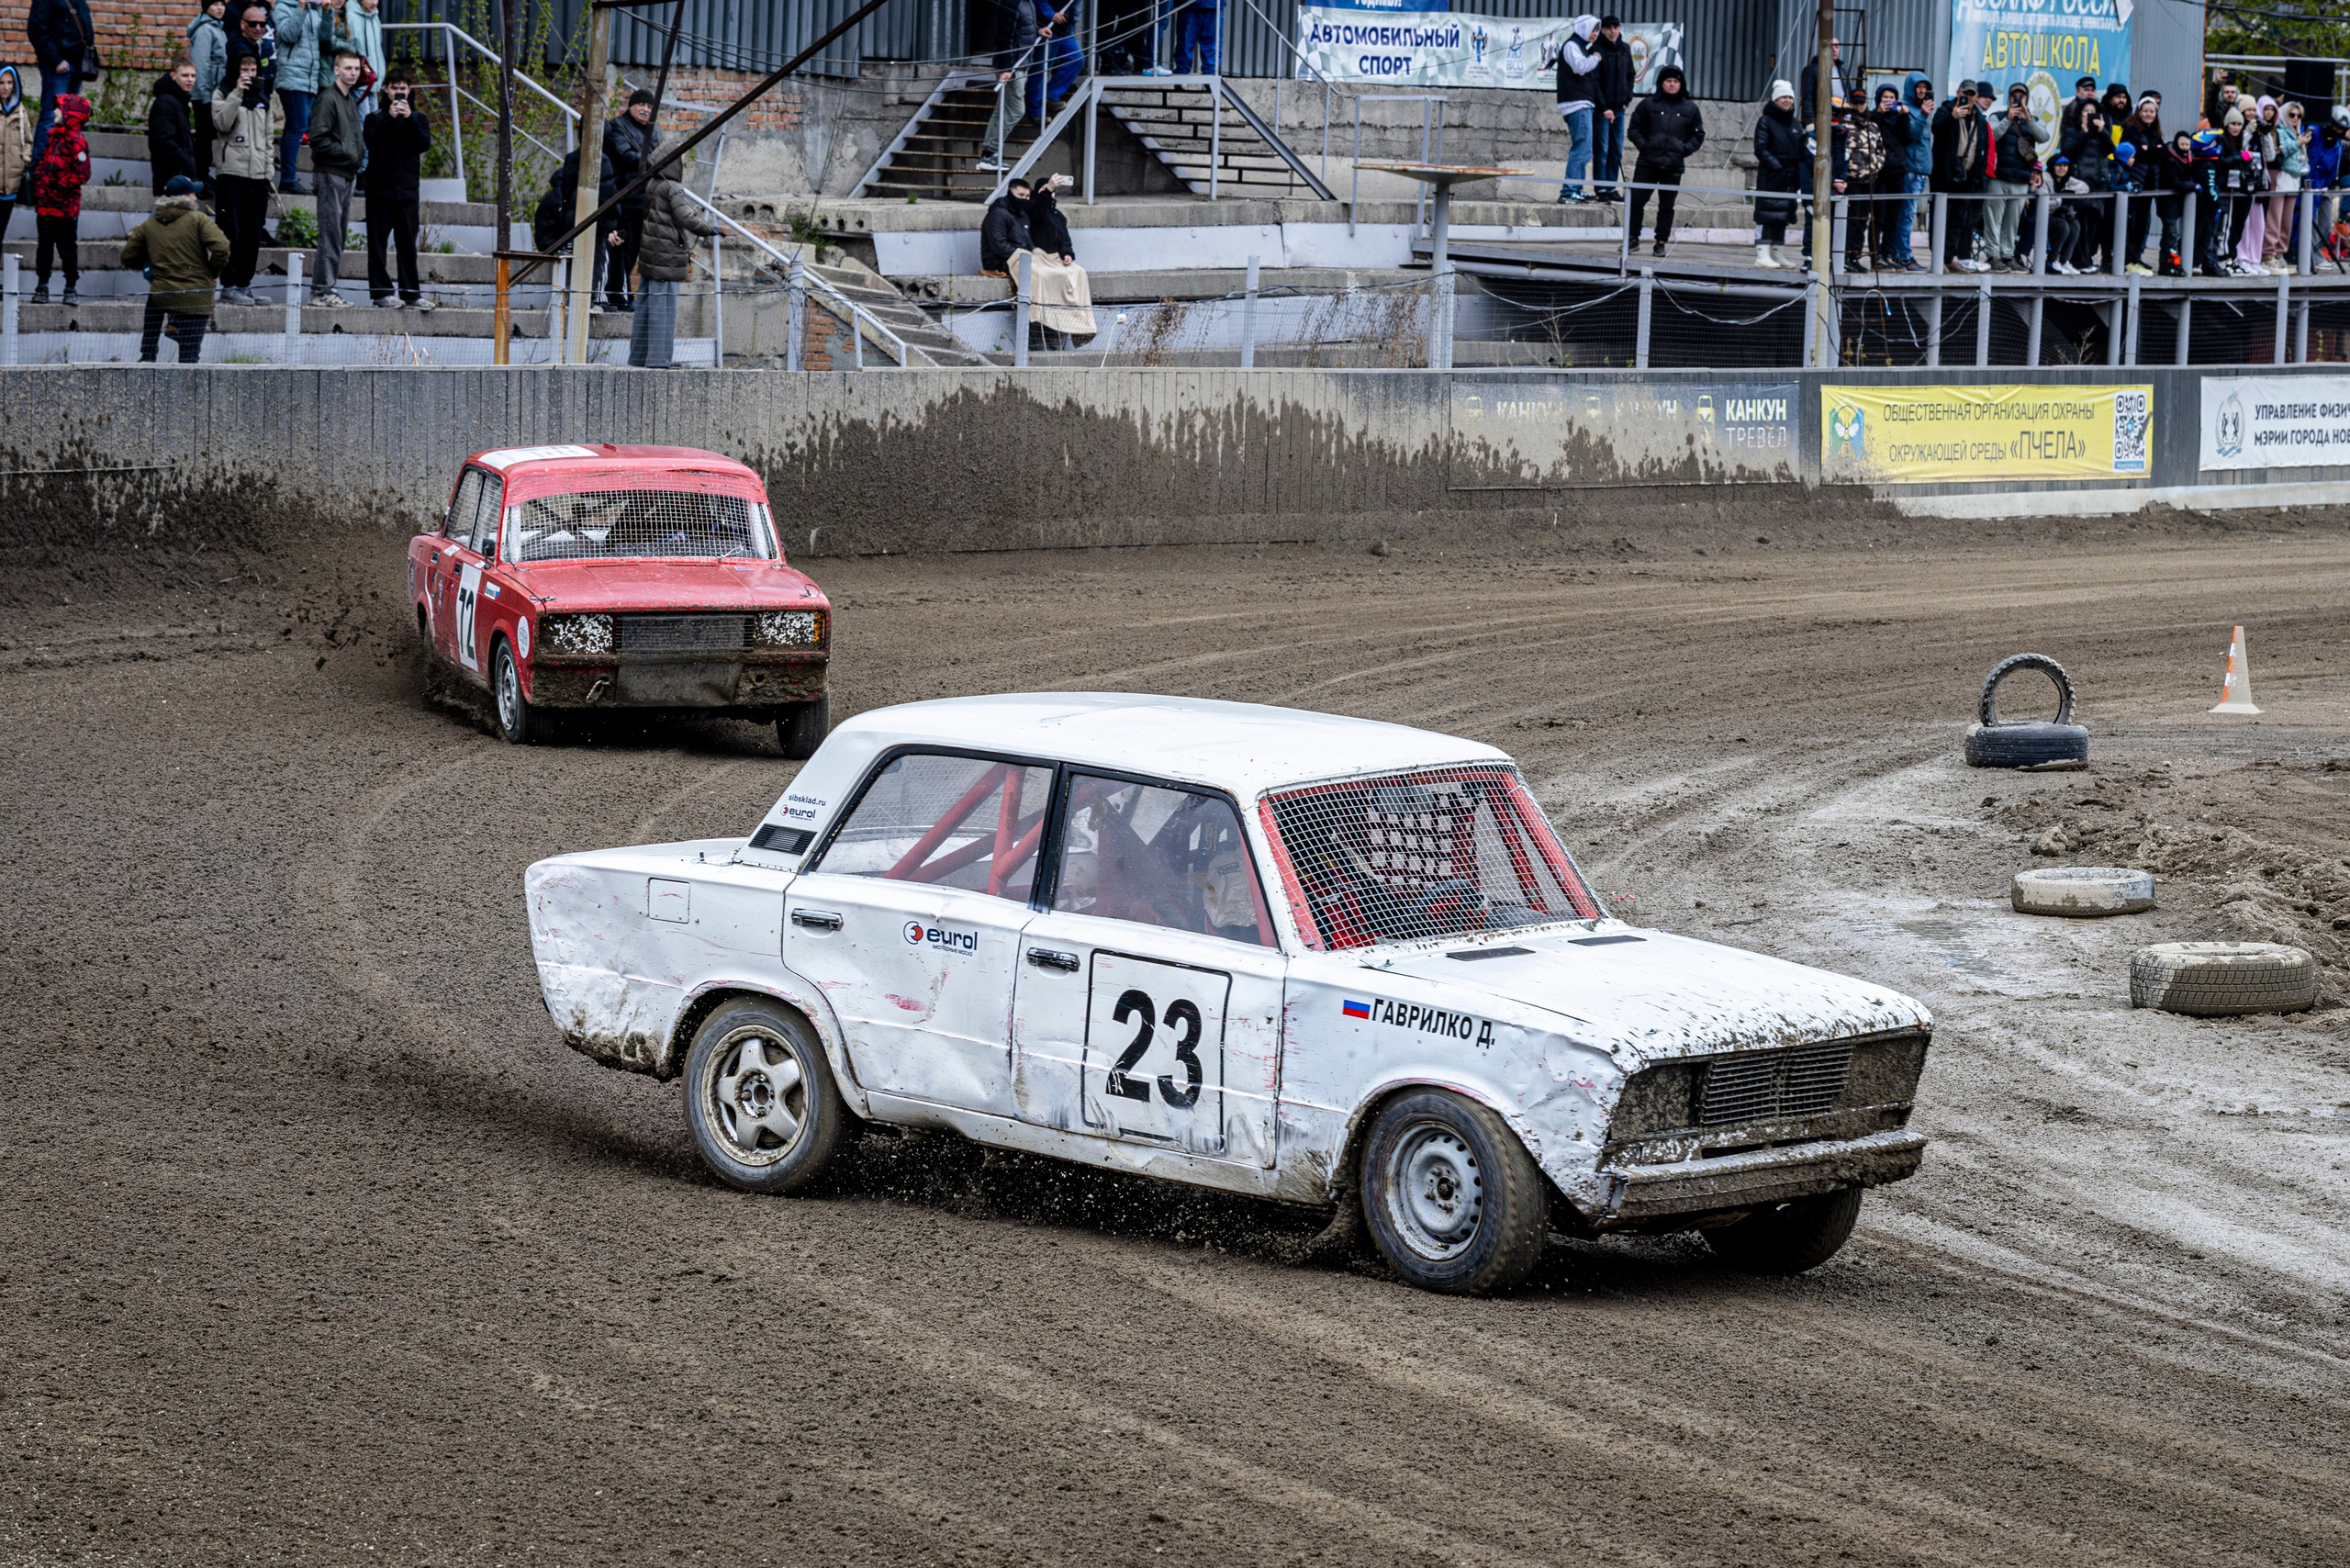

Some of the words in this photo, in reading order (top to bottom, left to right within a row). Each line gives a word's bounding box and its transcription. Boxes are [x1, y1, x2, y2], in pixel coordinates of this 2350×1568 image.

[1310, 24, 1460, 49] АВТОМОБИЛЬНЫЙ
[1980, 29, 2101, 77] АВТОШКОЛА
[1359, 55, 1412, 75] СПОРТ
[1726, 398, 1787, 421] КАНКУН
[1884, 403, 1971, 425] ОБЩЕСТВЕННАЯ
[1974, 402, 2049, 424] ОРГАНИЗАЦИЯ
[2052, 402, 2095, 420] ОХРАНЫ
[2255, 404, 2317, 420] УПРАВЛЕНИЕ
[1725, 426, 1787, 449] ТРЕВЕЛ
[1889, 441, 1967, 465] ОКРУЖАЮЩЕЙ
[1970, 442, 2007, 463] СРЕДЫ
[2010, 431, 2086, 459] «ПЧЕЛА»
[2255, 430, 2288, 446] МЭРИИ
[2290, 429, 2331, 447] ГОРОДА
[458, 587, 476, 661] 72
[789, 794, 826, 806] sibsklad.ru
[789, 808, 816, 818] eurol
[926, 928, 979, 951] eurol
[1371, 998, 1472, 1040] ГАВРИЛКО
[1476, 1020, 1495, 1049] Д.
[1105, 989, 1203, 1110] 23
